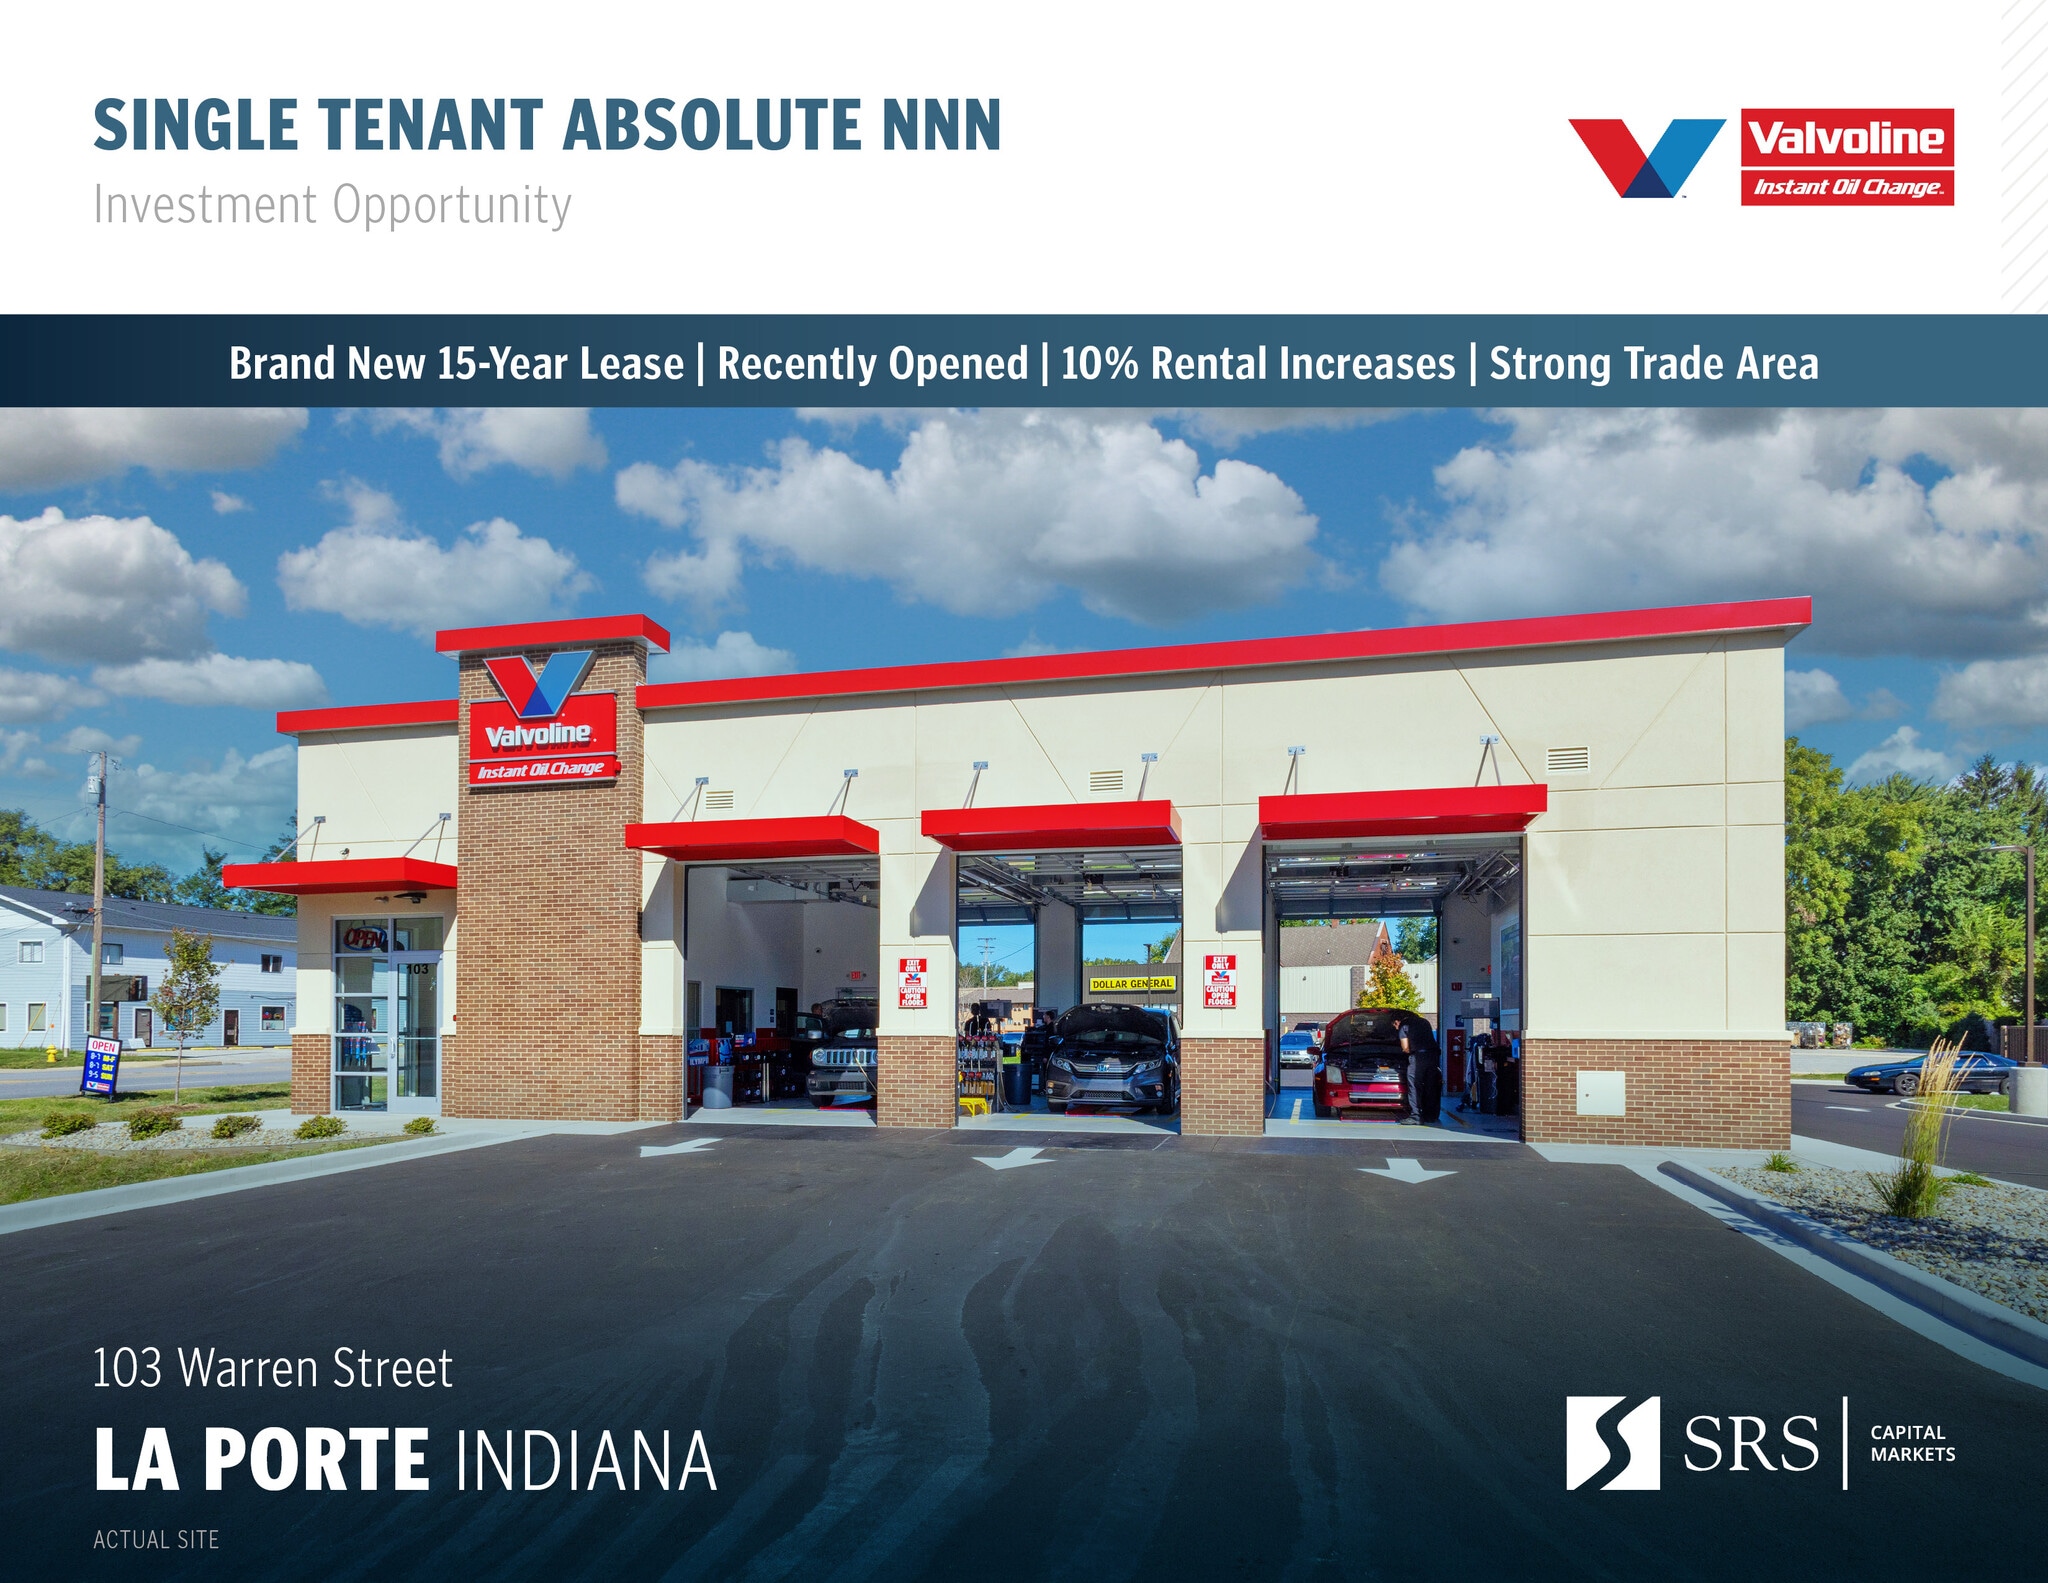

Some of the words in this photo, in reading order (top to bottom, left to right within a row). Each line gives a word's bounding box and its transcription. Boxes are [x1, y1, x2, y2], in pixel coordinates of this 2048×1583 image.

[485, 722, 591, 748] Valvoline
[478, 765, 528, 779] Instant
[550, 761, 605, 776] Change
[343, 927, 382, 948] OPEN
[406, 964, 429, 975] 103
[1211, 962, 1229, 970] ONLY
[1092, 980, 1128, 989] DOLLAR
[1130, 978, 1172, 988] GENERAL
[1208, 998, 1233, 1006] FLOORS
[92, 1040, 115, 1052] OPEN
